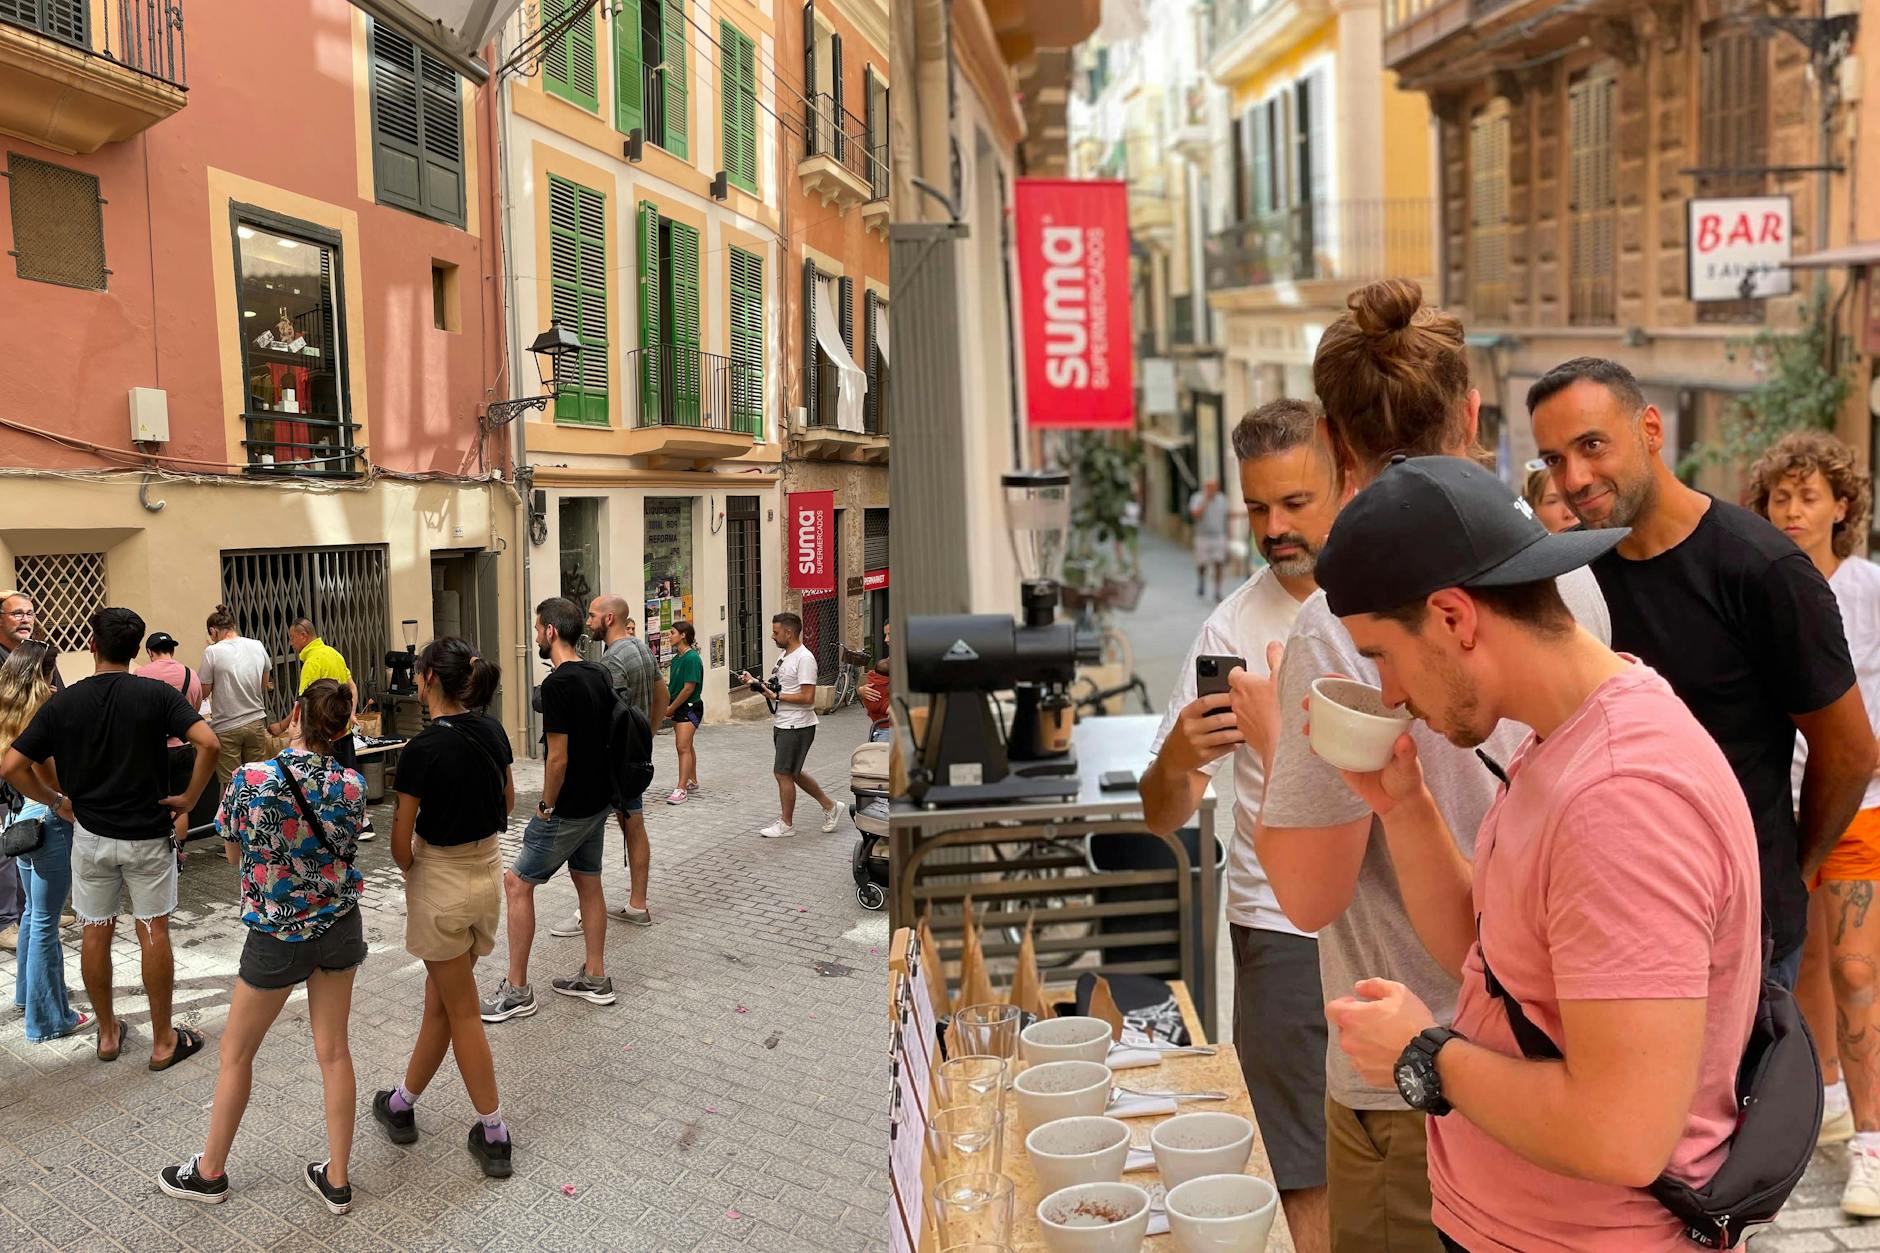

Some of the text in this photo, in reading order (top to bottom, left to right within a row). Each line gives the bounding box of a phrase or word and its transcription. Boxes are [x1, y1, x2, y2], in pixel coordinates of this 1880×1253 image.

[1697, 212, 1783, 254] BAR
[1042, 226, 1088, 389] suma
[648, 534, 678, 544] REFORMA
[799, 510, 816, 574] suma
